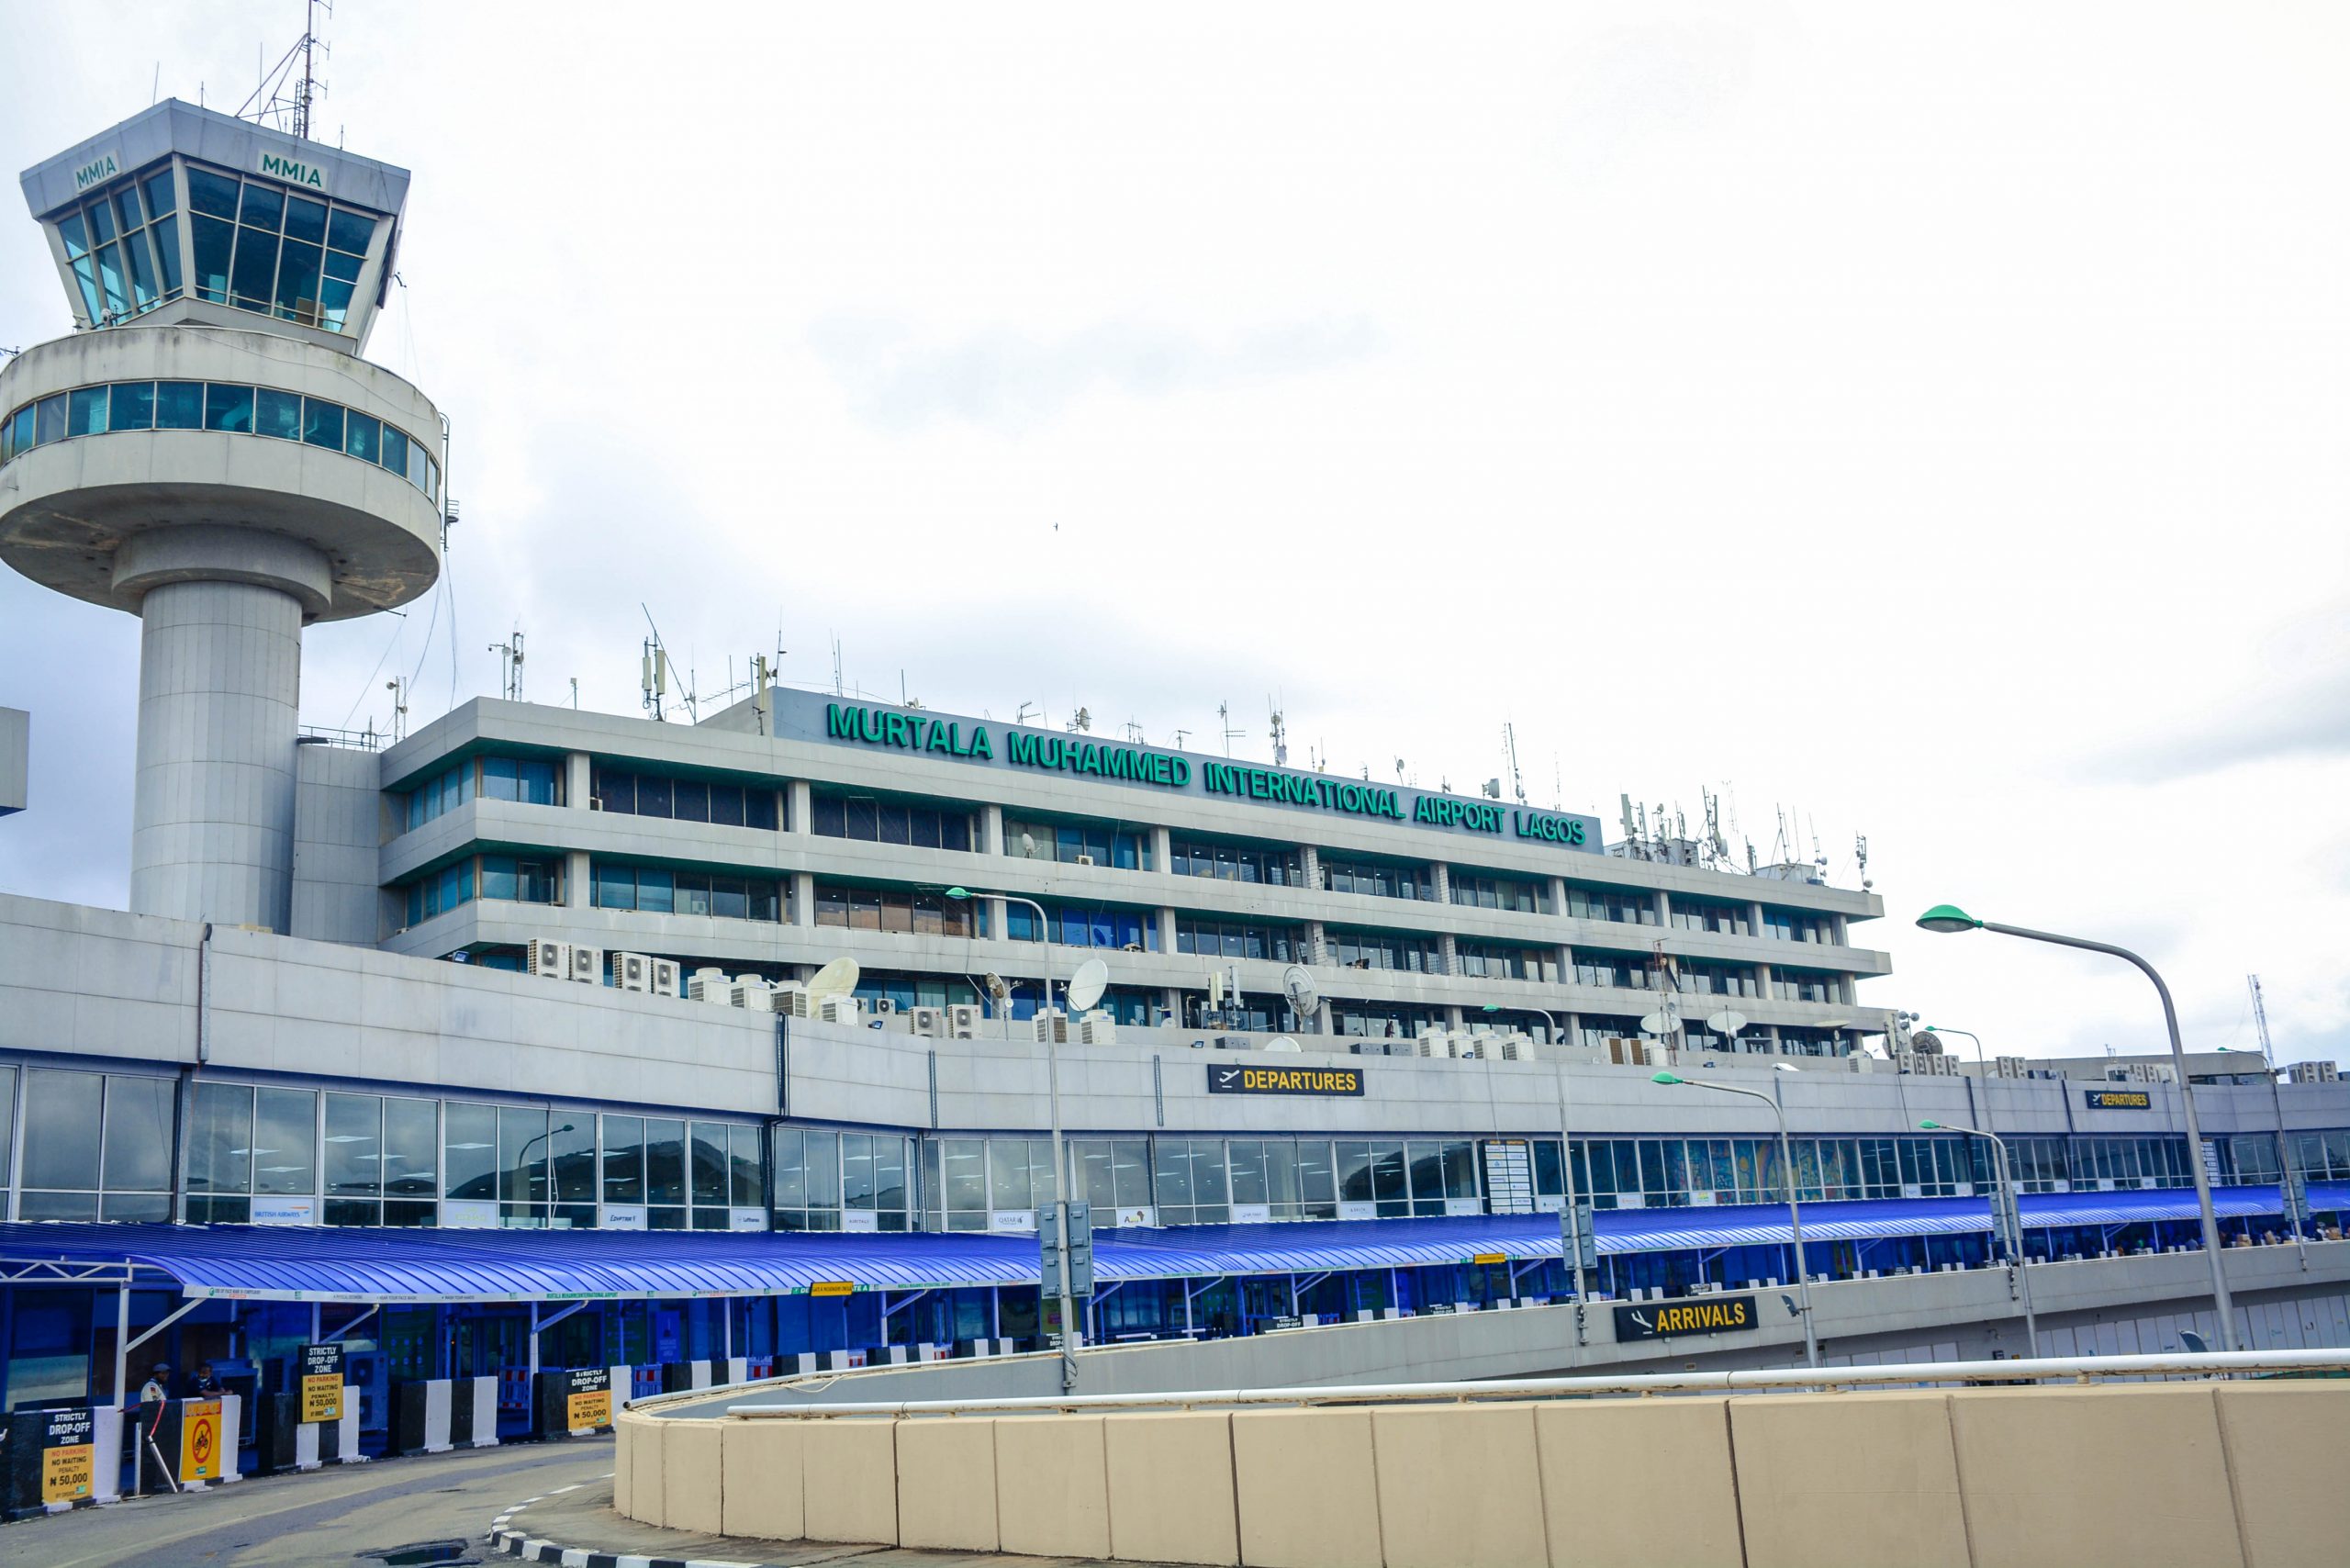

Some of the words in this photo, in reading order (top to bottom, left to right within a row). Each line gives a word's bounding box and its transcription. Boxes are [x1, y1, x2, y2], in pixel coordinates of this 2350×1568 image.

[76, 156, 117, 189] MMIA
[263, 154, 321, 187] MMIA
[827, 703, 993, 759] MURTALA
[1008, 731, 1191, 786] MUHAMMED
[1204, 761, 1405, 820] INTERNATIONAL
[1414, 795, 1505, 833] AIRPORT
[1514, 810, 1585, 845] LAGOS
[1244, 1070, 1357, 1091] DEPARTURES
[2100, 1093, 2148, 1106] DEPARTURES
[1657, 1303, 1745, 1332] ARRIVALS
[309, 1346, 337, 1356] STRICTLY
[308, 1355, 338, 1365] DROP-OFF
[314, 1365, 332, 1373] ZONE
[572, 1375, 607, 1386] DROP-OFF
[316, 1398, 337, 1406] 50,000
[55, 1412, 87, 1422] STRICTLY
[582, 1409, 606, 1418] 50,000
[49, 1422, 91, 1436] DROP-OFF
[61, 1435, 80, 1445] ZONE
[62, 1456, 87, 1465] WAITING
[59, 1473, 88, 1486] 50,000
